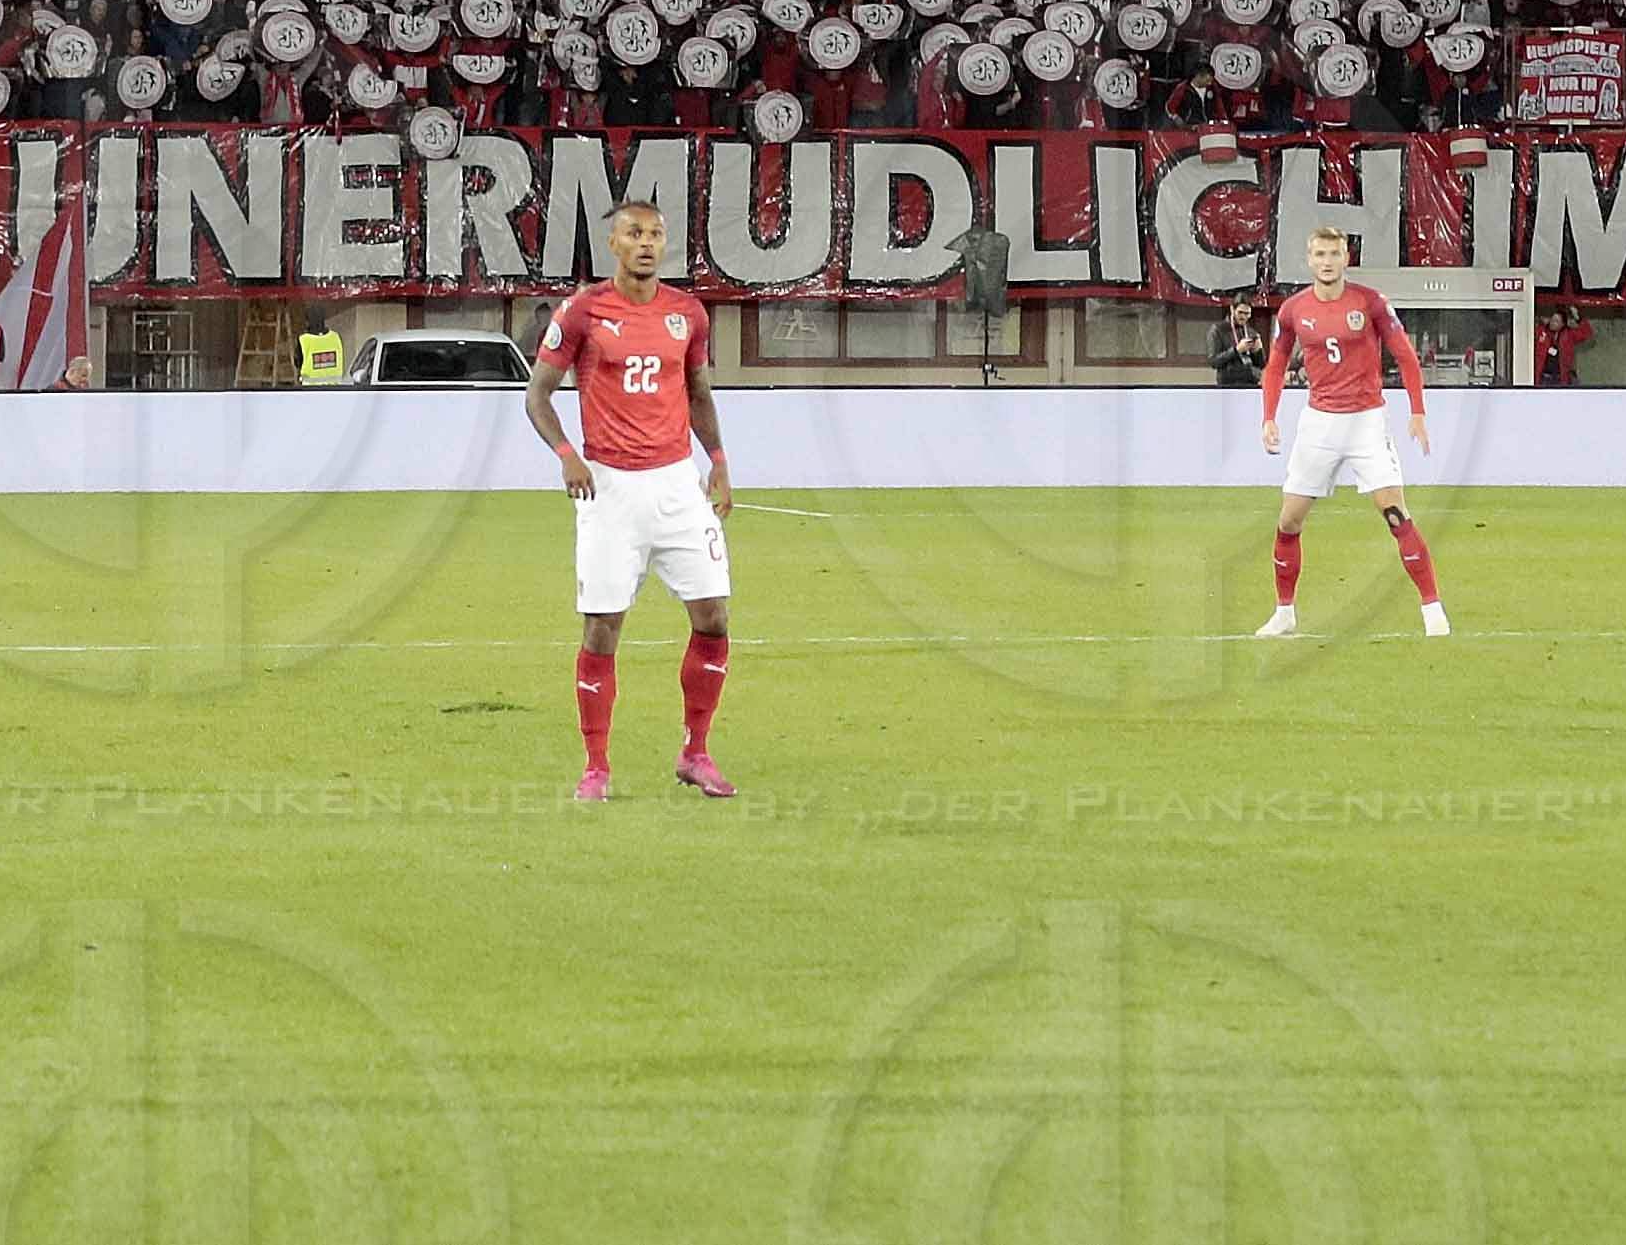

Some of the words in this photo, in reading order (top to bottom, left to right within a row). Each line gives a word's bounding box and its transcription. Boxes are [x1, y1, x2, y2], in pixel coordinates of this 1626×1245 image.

[1525, 38, 1620, 60] HEIMSPIELE
[1549, 76, 1579, 92] NUR
[1546, 95, 1596, 113] WIEN
[1493, 279, 1523, 292] ORF
[1325, 336, 1343, 365] 5
[623, 355, 663, 394] 22
